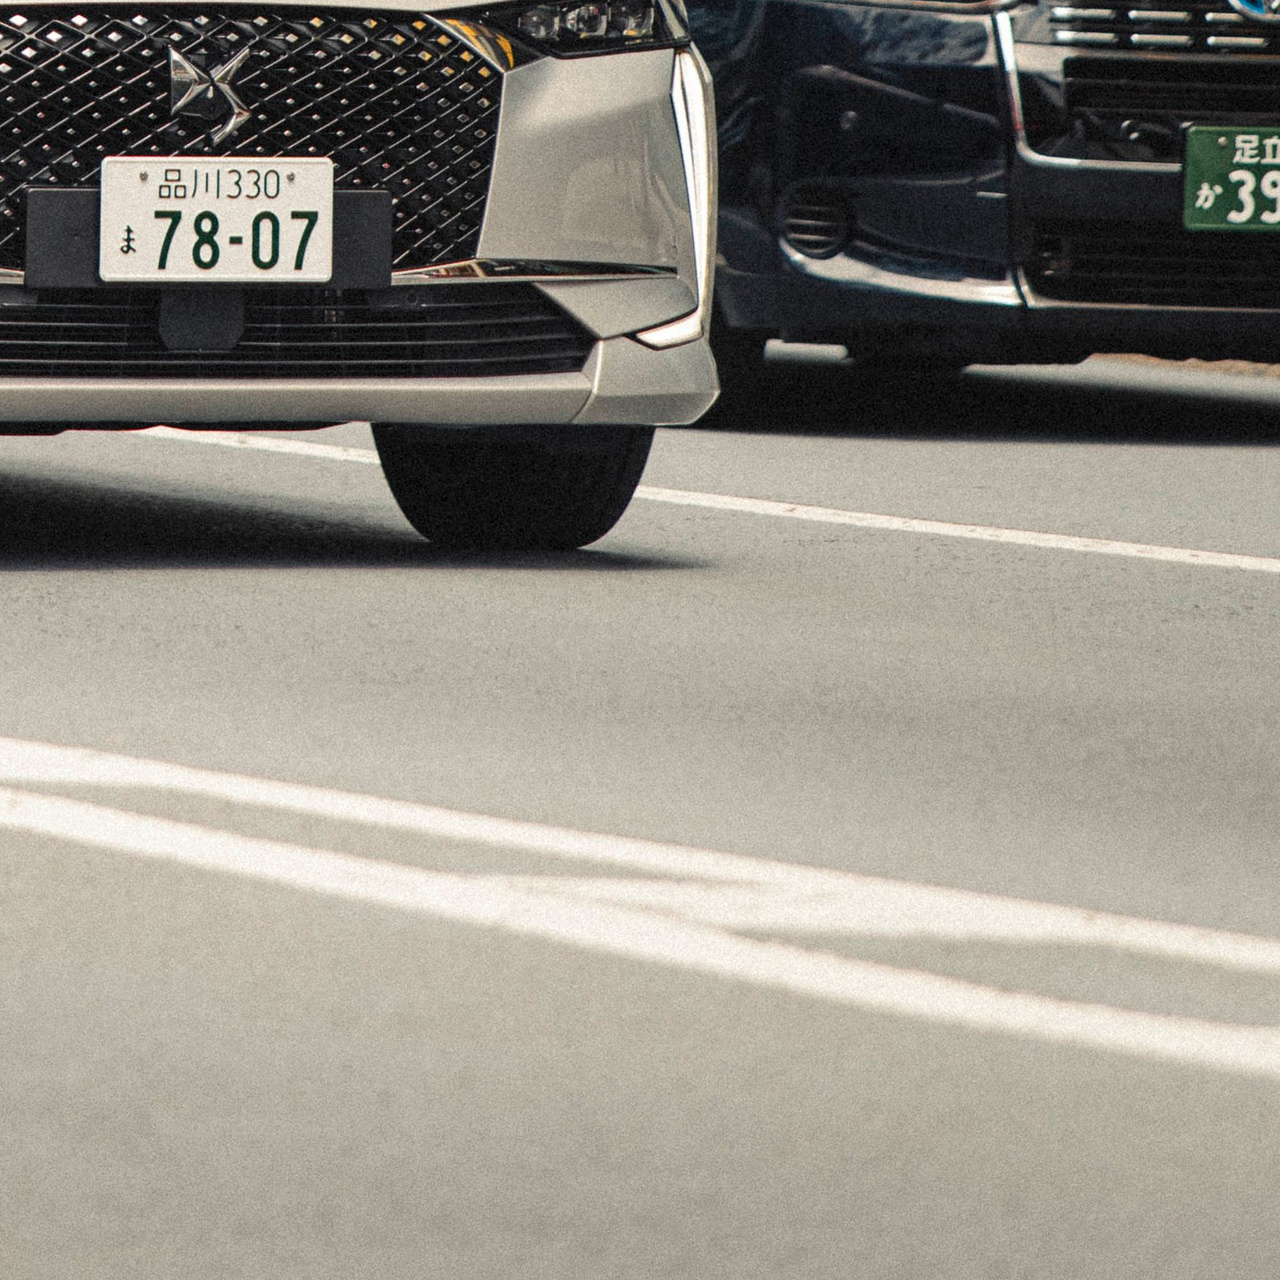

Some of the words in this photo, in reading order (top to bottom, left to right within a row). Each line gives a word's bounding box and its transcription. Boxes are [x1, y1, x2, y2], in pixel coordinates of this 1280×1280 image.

[1227, 169, 1280, 224] 39
[120, 225, 136, 254] ま
[154, 210, 319, 270] 78-07
